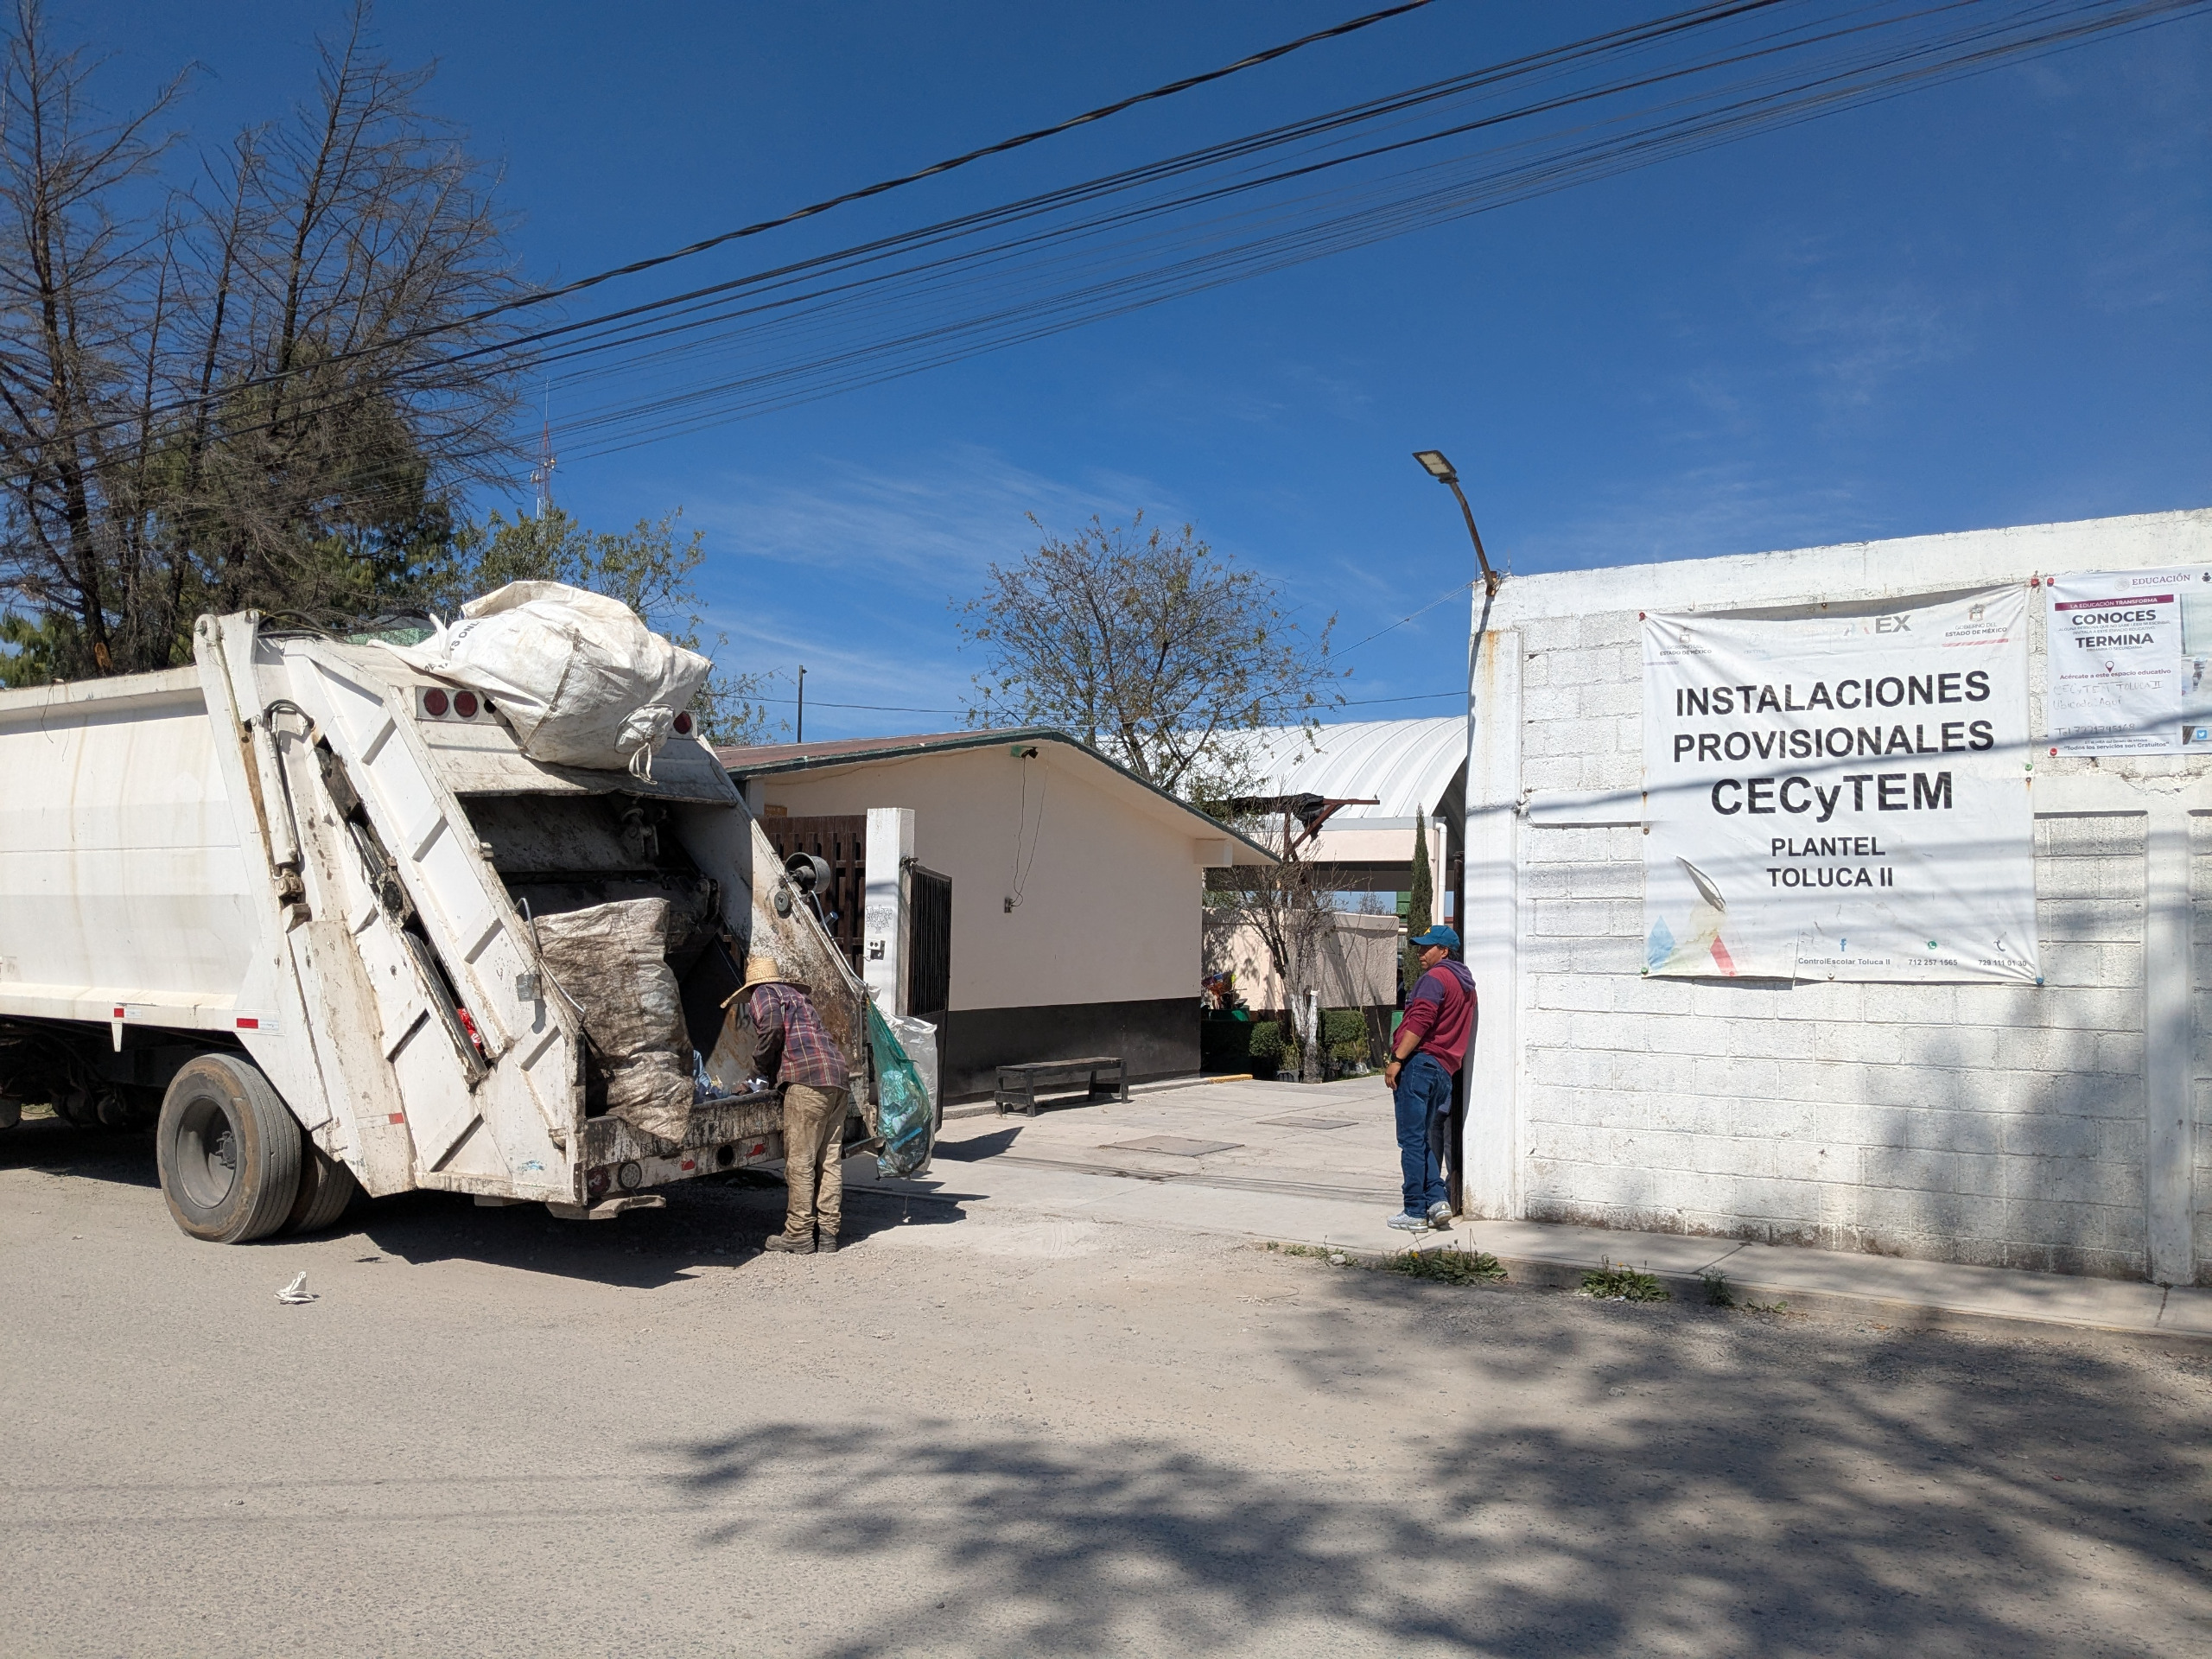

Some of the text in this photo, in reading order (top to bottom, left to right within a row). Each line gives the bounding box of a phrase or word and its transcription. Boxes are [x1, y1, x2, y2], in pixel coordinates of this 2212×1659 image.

[2132, 573, 2190, 585] EDUCACIÓN
[2115, 597, 2158, 606] TRANSFORMA
[2072, 609, 2156, 626] CONOCES
[2075, 632, 2154, 648] TERMINA
[1675, 671, 1991, 717] INSTALACIONES
[1674, 720, 1994, 763] PROVISIONALES
[1711, 771, 1953, 823] CECyTEM
[1771, 836, 1885, 857] PLANTEL
[1766, 867, 1893, 887] TOLUCA II
[1798, 957, 1855, 965] ControlEscolar
